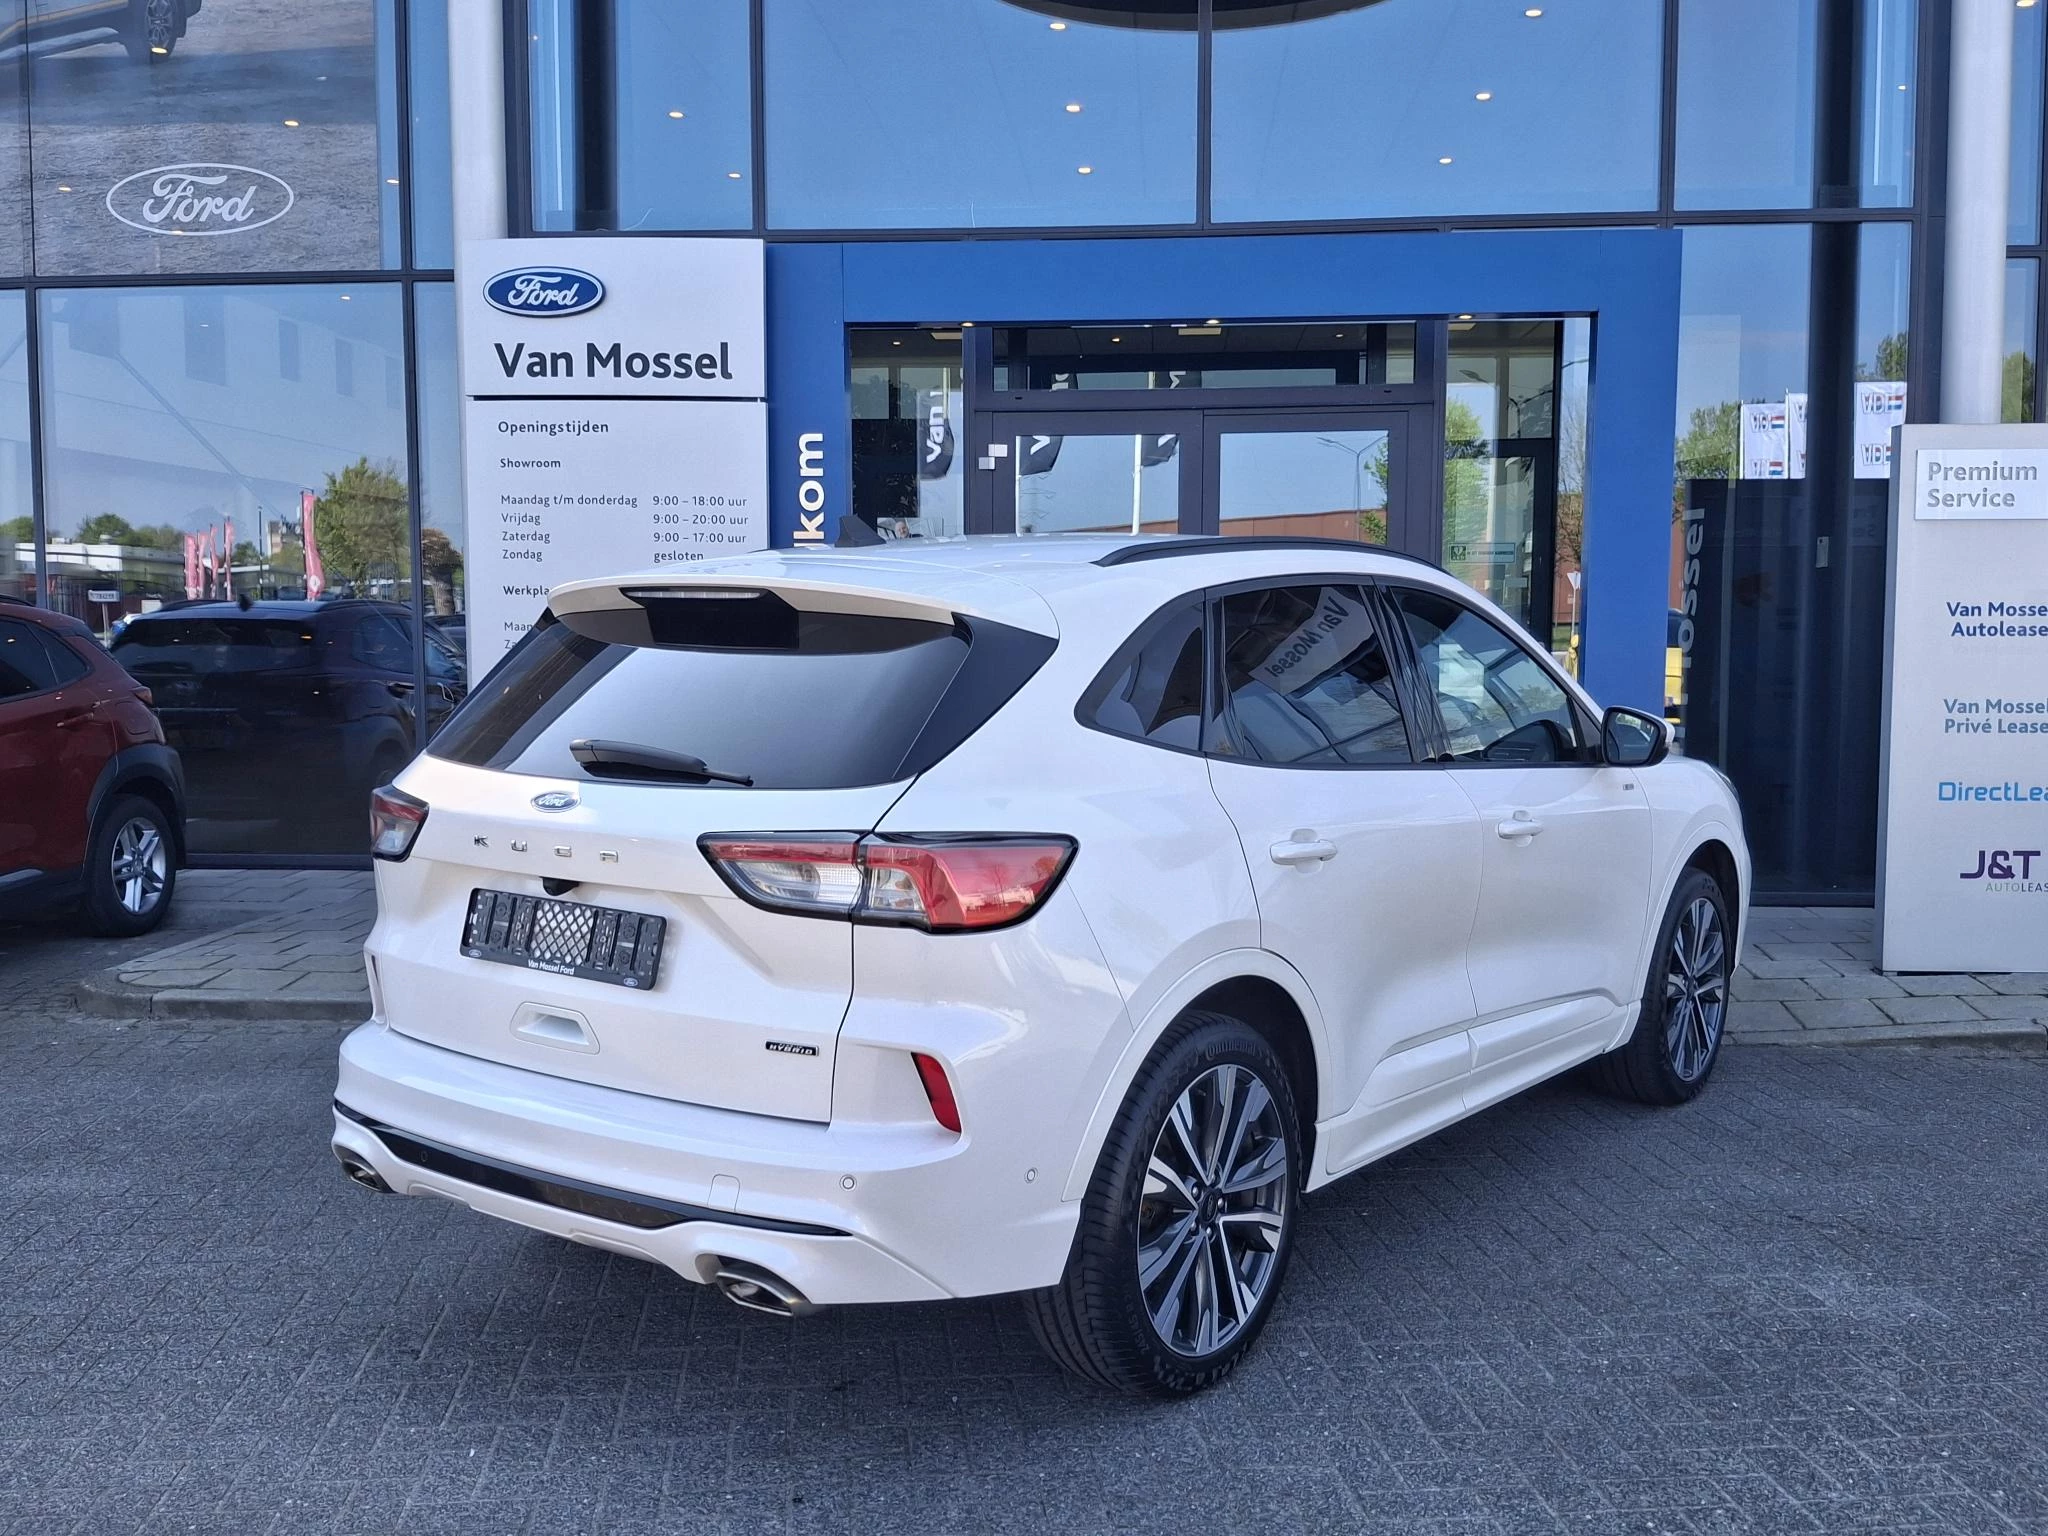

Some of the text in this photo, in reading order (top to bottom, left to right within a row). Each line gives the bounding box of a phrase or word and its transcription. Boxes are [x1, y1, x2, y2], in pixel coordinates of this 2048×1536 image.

[143, 173, 258, 223] Ford
[507, 274, 580, 307] Ford
[493, 341, 733, 380] Van Mossel
[497, 420, 610, 436] Openingstijden
[500, 457, 561, 469] Showroom
[1928, 460, 2037, 481] Premium
[501, 494, 638, 509] Maandag t/m donderdag
[652, 495, 679, 506] 9:00
[692, 495, 725, 507] 18:00
[728, 498, 748, 507] uur
[1927, 487, 2016, 508] Service
[501, 512, 541, 526] Vrijdag
[653, 513, 679, 524] 9:00
[692, 514, 726, 525] 20:00
[729, 517, 749, 525] uur
[502, 530, 551, 544] Zaterdag
[653, 532, 680, 543] 9:00
[692, 532, 724, 543] 17:00
[727, 535, 747, 543] uur
[502, 549, 543, 563] Zondag
[653, 549, 704, 564] gesloten
[1946, 601, 1982, 617] Van
[1951, 620, 2048, 637] Autolease
[1943, 698, 1980, 714] Van
[1944, 718, 2048, 734] Privé Lease
[474, 834, 619, 863] KUGA
[1959, 850, 2041, 880] J&T
[527, 958, 575, 976] Van Mossel Ford
[769, 1043, 813, 1056] HYBRID
